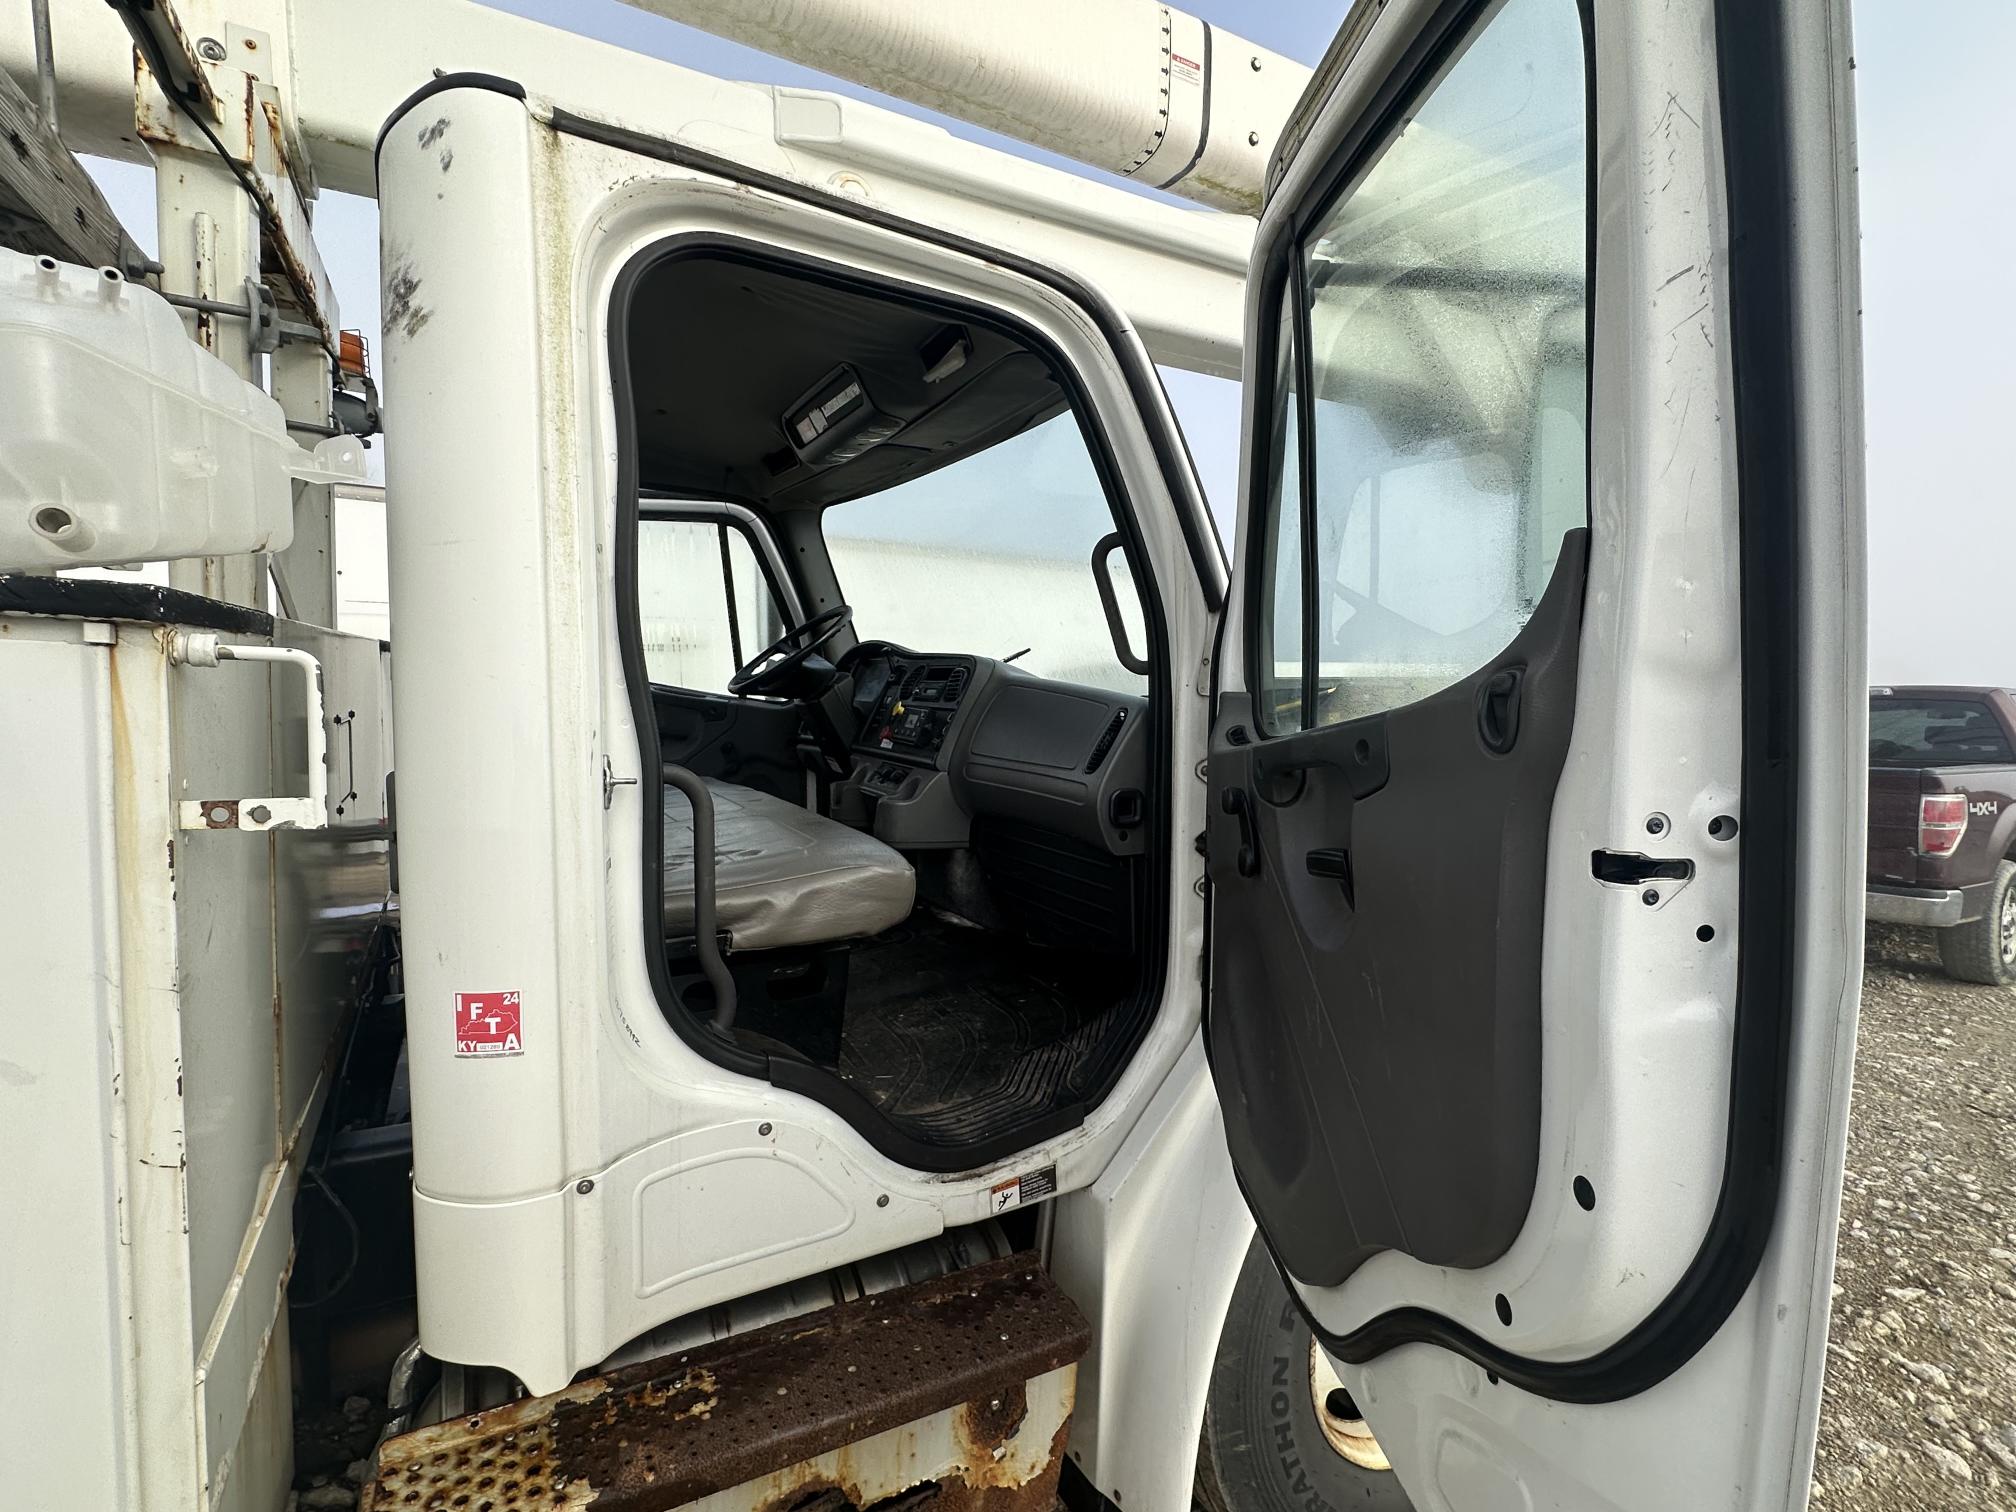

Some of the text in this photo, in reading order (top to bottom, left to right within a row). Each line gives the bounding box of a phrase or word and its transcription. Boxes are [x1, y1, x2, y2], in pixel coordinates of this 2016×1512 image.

[503, 992, 519, 1005] 24
[458, 1040, 477, 1051] KY
[1270, 1356, 1336, 1512] RATHON
